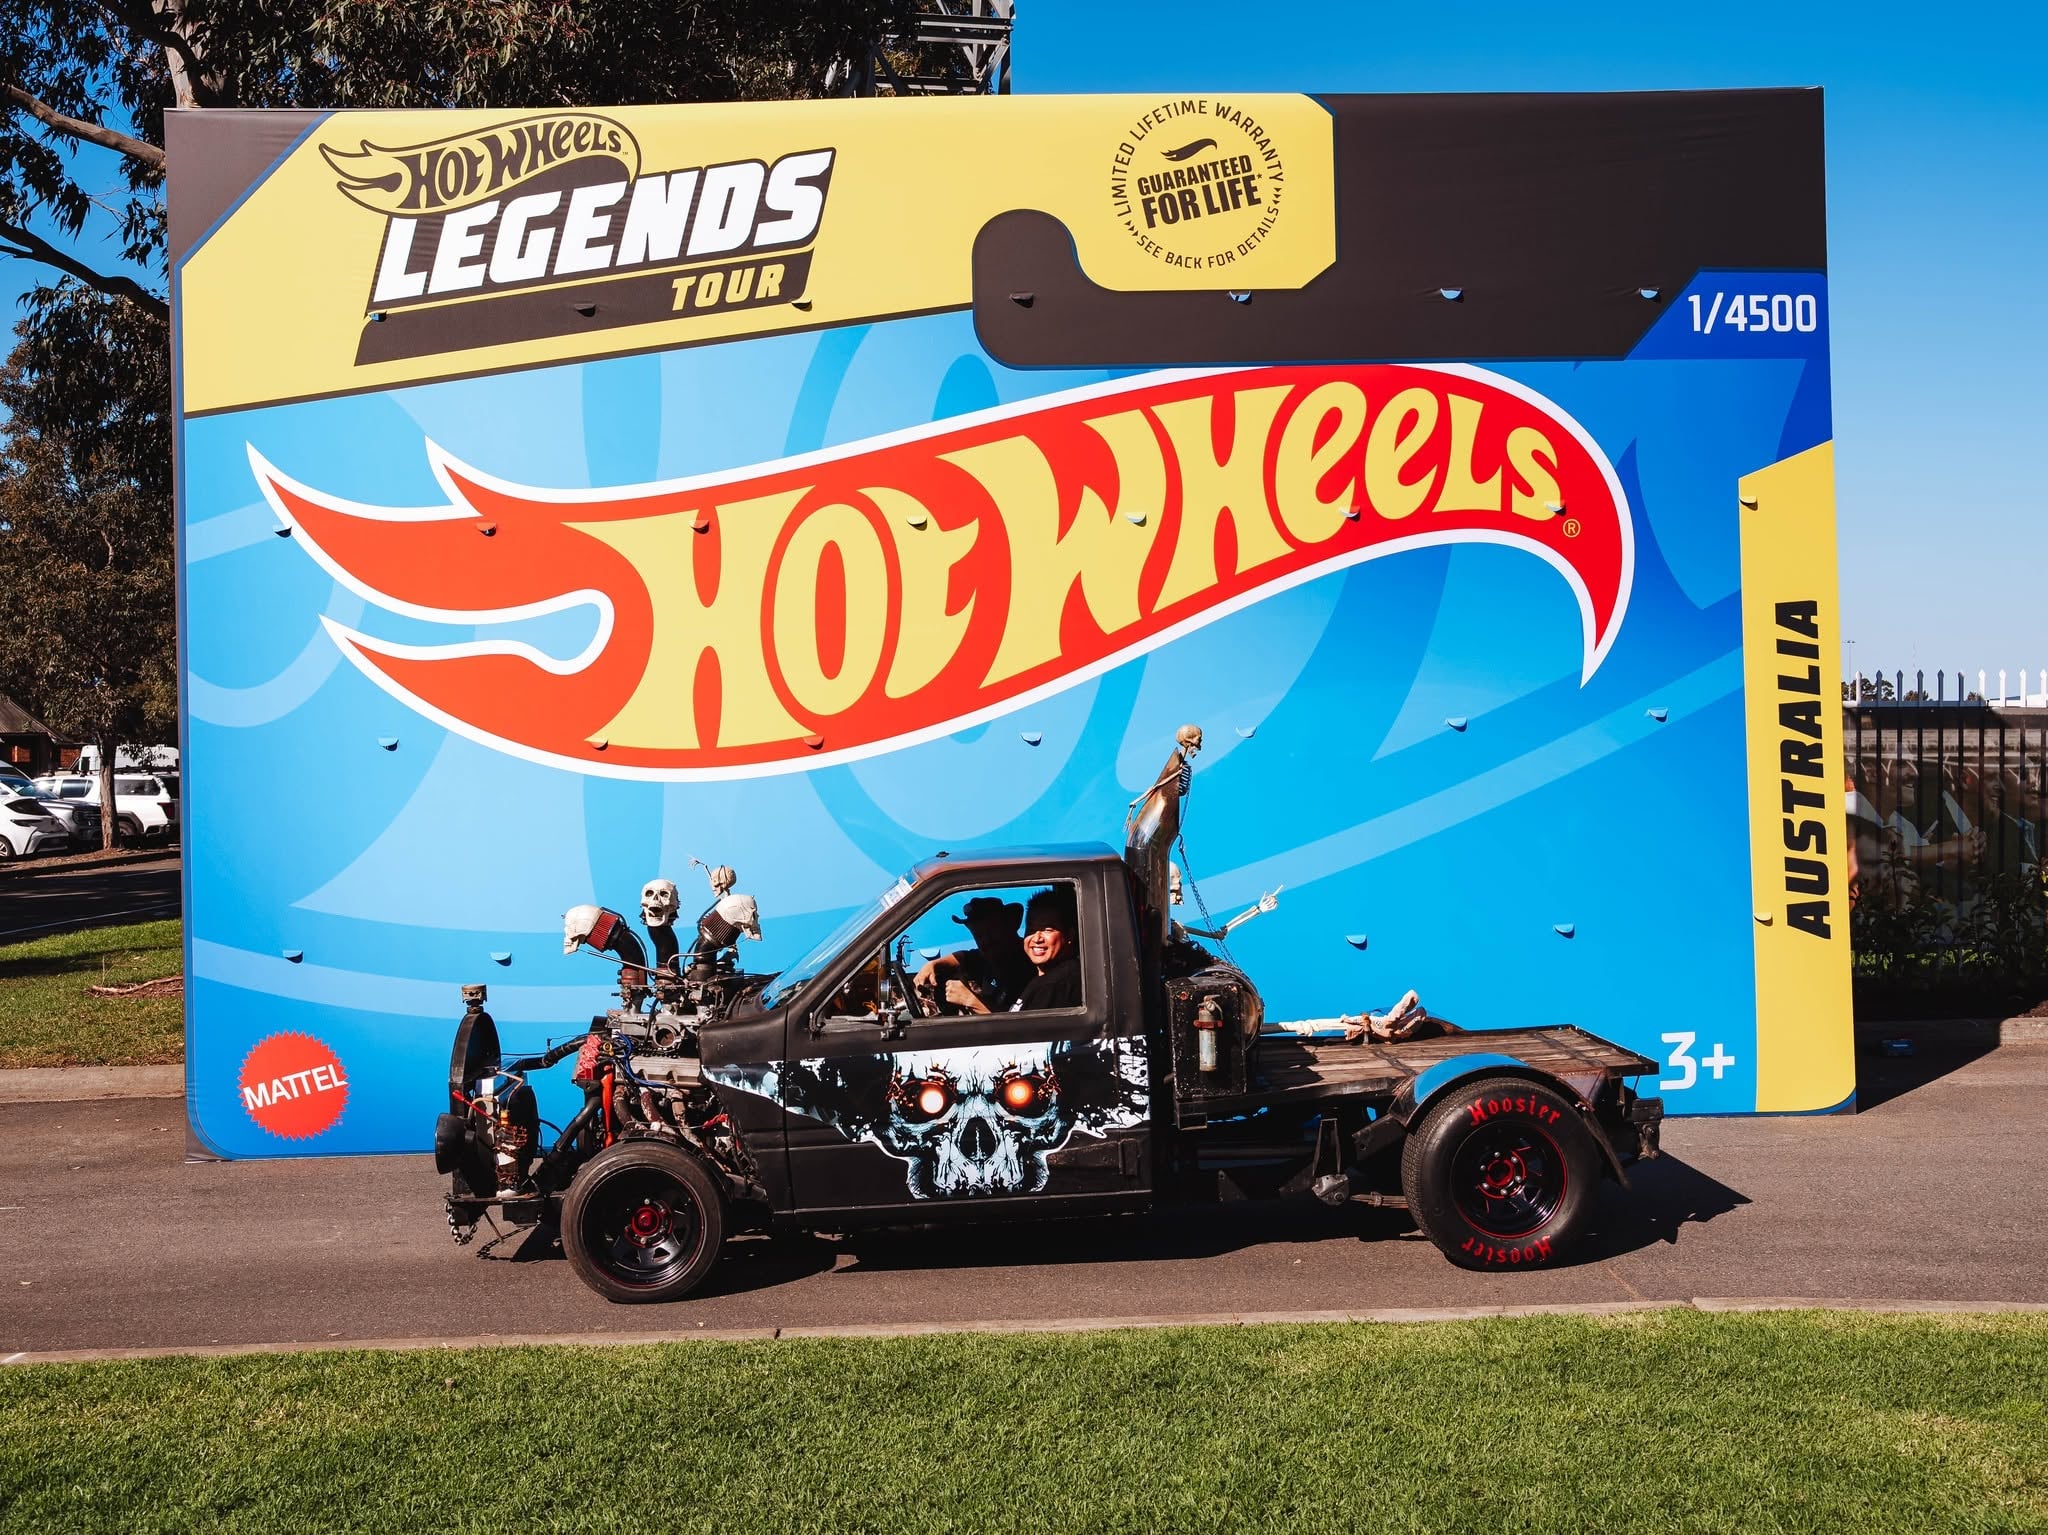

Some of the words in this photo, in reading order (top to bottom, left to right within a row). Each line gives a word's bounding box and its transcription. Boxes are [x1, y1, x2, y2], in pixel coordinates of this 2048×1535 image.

[395, 147, 485, 210] HOT
[1111, 142, 1135, 217] LIMITED
[1129, 99, 1208, 142] LIFETIME
[1215, 102, 1284, 182] WARRANTY
[1137, 155, 1253, 196] GUARANTEED
[373, 151, 833, 303] LEGENDS
[1136, 234, 1163, 259] SEE
[1165, 251, 1202, 269] BACK
[1207, 250, 1236, 268] FOR
[1236, 205, 1280, 256] DETAILS
[1141, 188, 1201, 229] FOR
[670, 264, 786, 311] TOUR
[1688, 292, 1817, 334] 1/4500
[560, 485, 980, 751] HOT
[1774, 600, 1832, 940] AUSTRALIA
[242, 1063, 348, 1111] MATTEL
[1659, 1031, 1735, 1091] 3+
[1467, 1095, 1561, 1127] Hoosier
